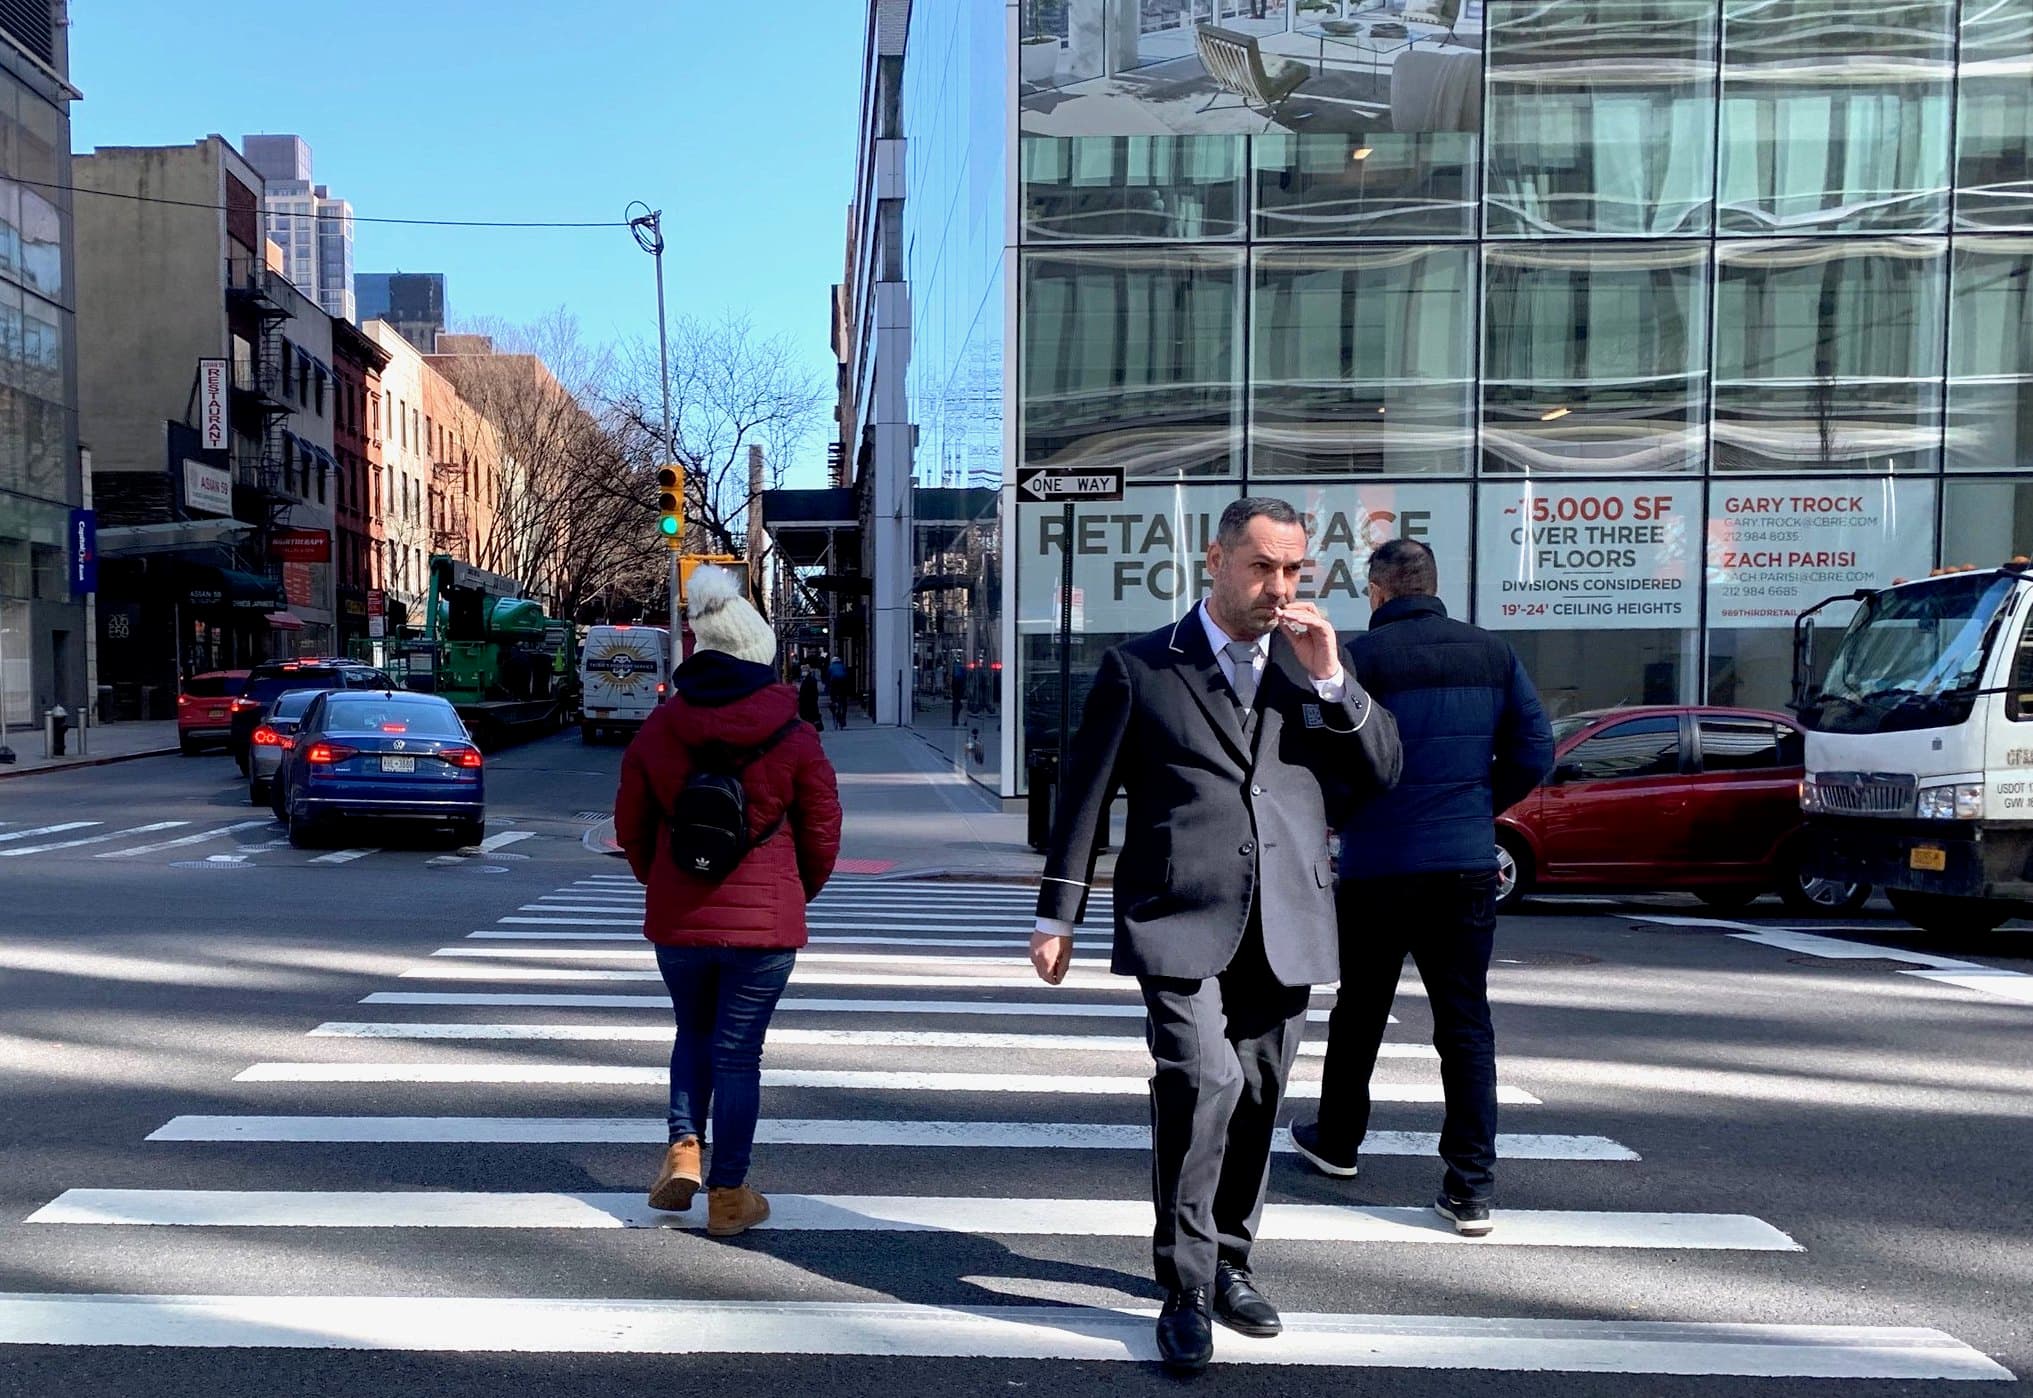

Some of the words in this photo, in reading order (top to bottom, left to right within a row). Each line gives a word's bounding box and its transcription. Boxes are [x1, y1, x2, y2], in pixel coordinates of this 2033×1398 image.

[208, 369, 221, 447] RESTAURANT
[201, 477, 220, 492] ASIAN
[1033, 478, 1063, 492] ONE
[1078, 478, 1110, 492] WAY
[1633, 496, 1673, 520] SF
[1725, 497, 1785, 513] GARY
[1790, 497, 1863, 513] TROCK
[1039, 513, 1210, 555] RETAIL
[1296, 511, 1432, 551] PACE
[1511, 526, 1578, 545] OVER
[1585, 526, 1665, 544] THREE
[1744, 531, 1767, 541] 984
[1538, 550, 1637, 569] FLOORS
[1724, 552, 1782, 567] ZACH
[1789, 552, 1856, 567] PARISI
[1726, 571, 1875, 583] CH.PARISI@CBRE.COM
[1502, 579, 1579, 592] DIVISIONS
[1583, 578, 1682, 591] CONSIDERED
[1722, 586, 1740, 597] 212
[1742, 586, 1766, 597] 984
[1502, 604, 1549, 616] 19'-24'
[1553, 603, 1613, 616] CEILING
[1617, 602, 1682, 615] HEIGHTS
[1997, 782, 2026, 795] USDOT
